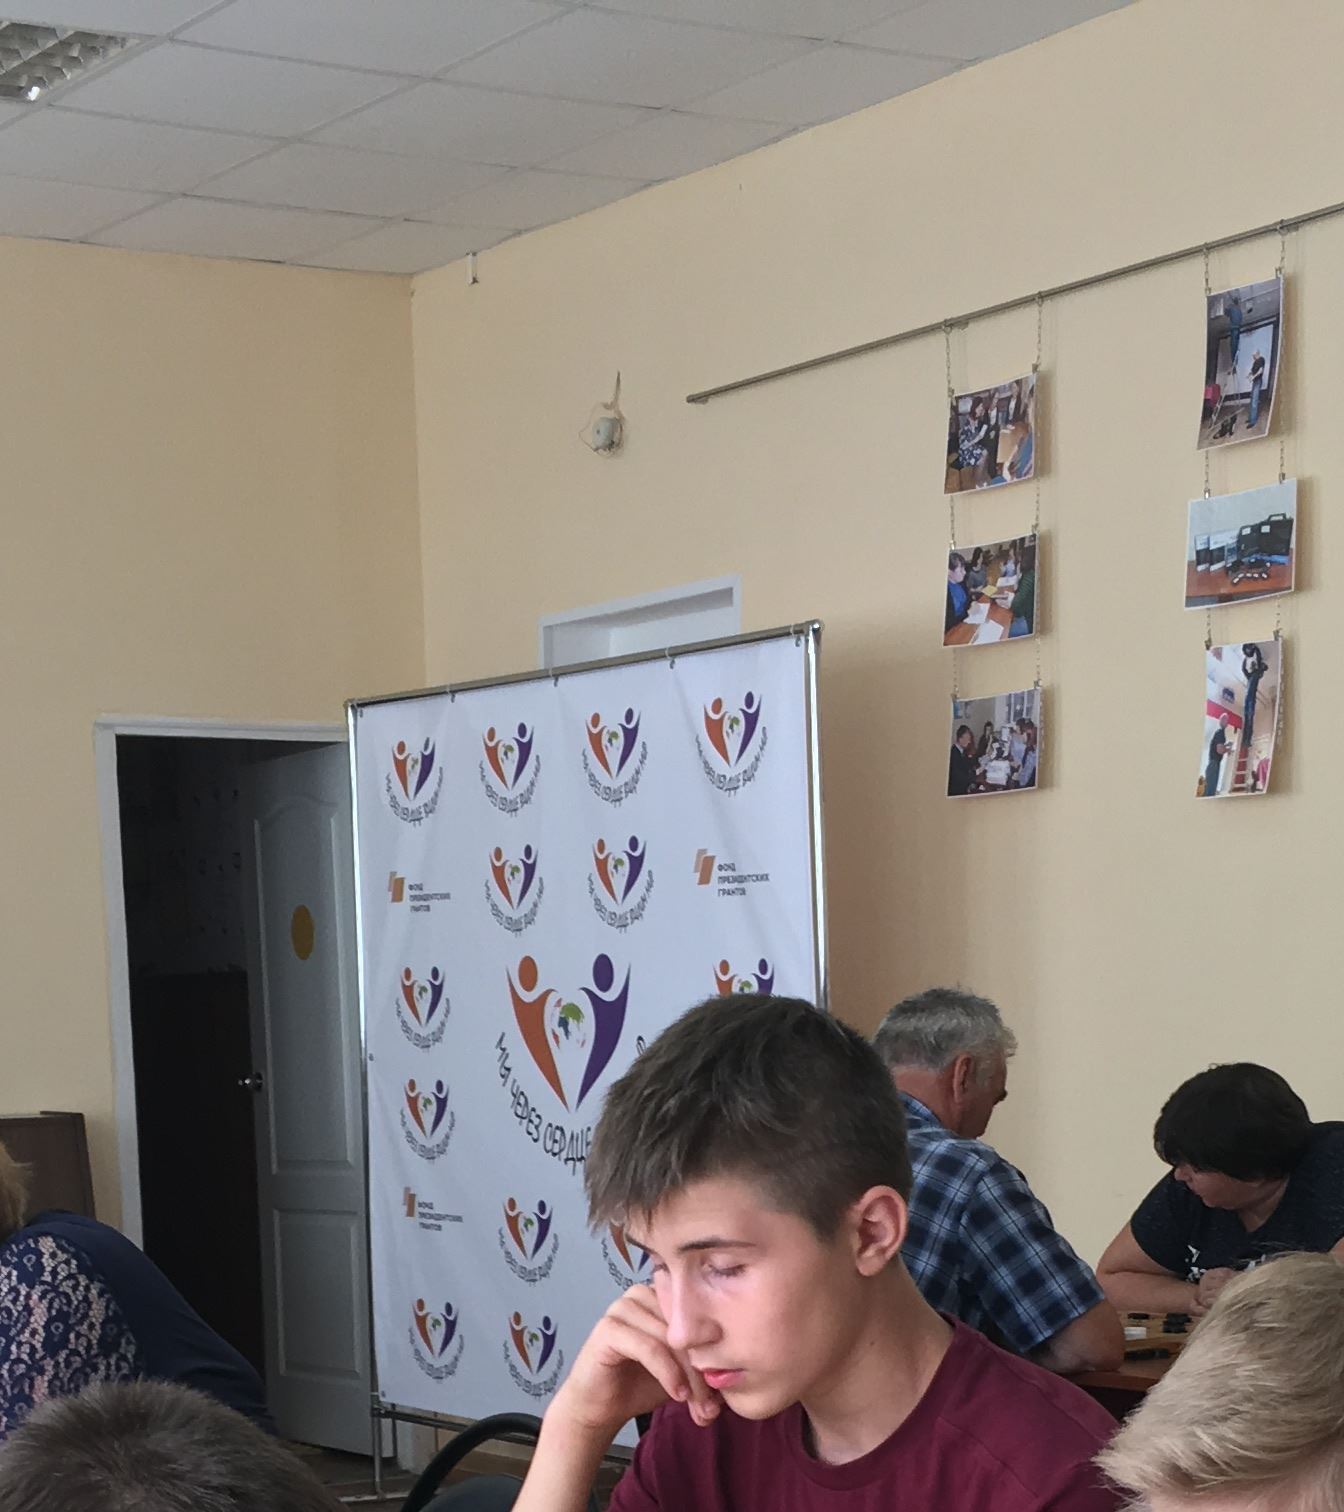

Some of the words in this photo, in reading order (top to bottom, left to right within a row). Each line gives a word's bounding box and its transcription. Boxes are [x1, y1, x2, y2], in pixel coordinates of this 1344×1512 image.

[717, 863, 736, 872] ФОНД
[717, 887, 747, 897] ГРАНТОВ
[495, 1031, 512, 1087] МЫ
[510, 1078, 543, 1143] ЧЕРЕЗ
